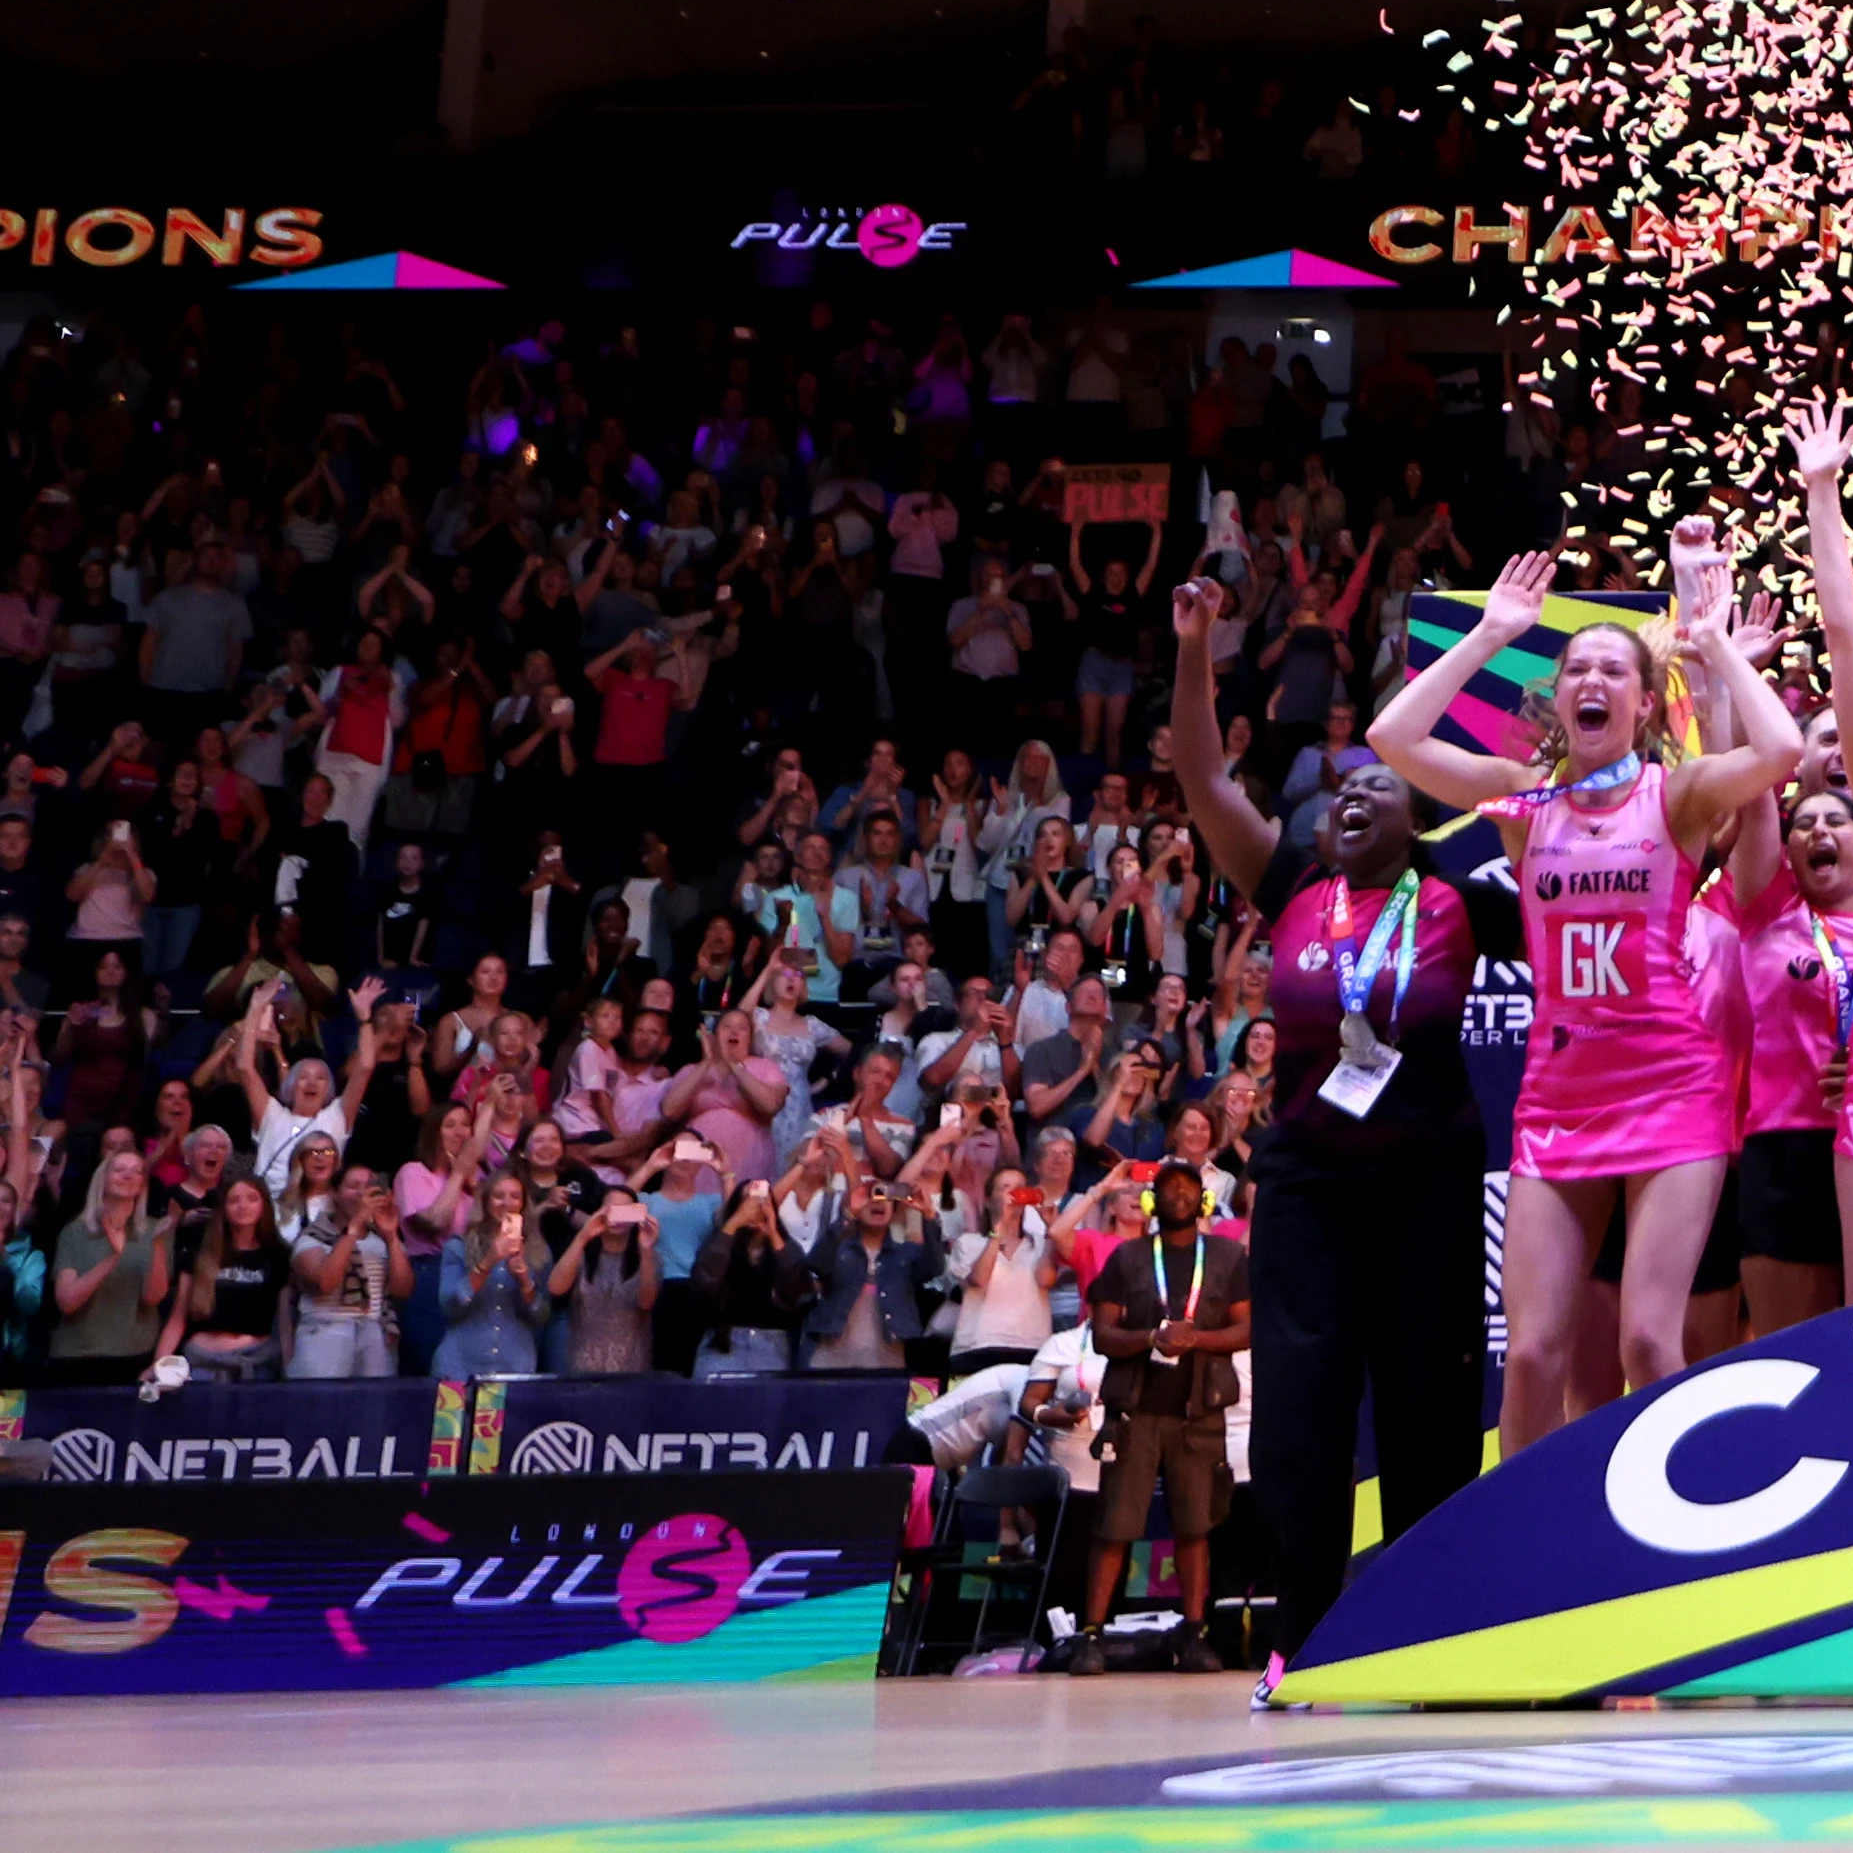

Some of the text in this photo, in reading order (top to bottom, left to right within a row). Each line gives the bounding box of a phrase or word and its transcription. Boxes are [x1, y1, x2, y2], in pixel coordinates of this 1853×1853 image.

[731, 211, 967, 260] PULSE
[1063, 483, 1169, 524] PULSE
[1568, 870, 1651, 895] FATFACE
[1561, 920, 1631, 998] GK
[124, 1435, 415, 1482] NETBALL
[602, 1431, 872, 1474] NETBALL
[510, 1524, 708, 1544] LONDON
[356, 1529, 843, 1627] PULSE
